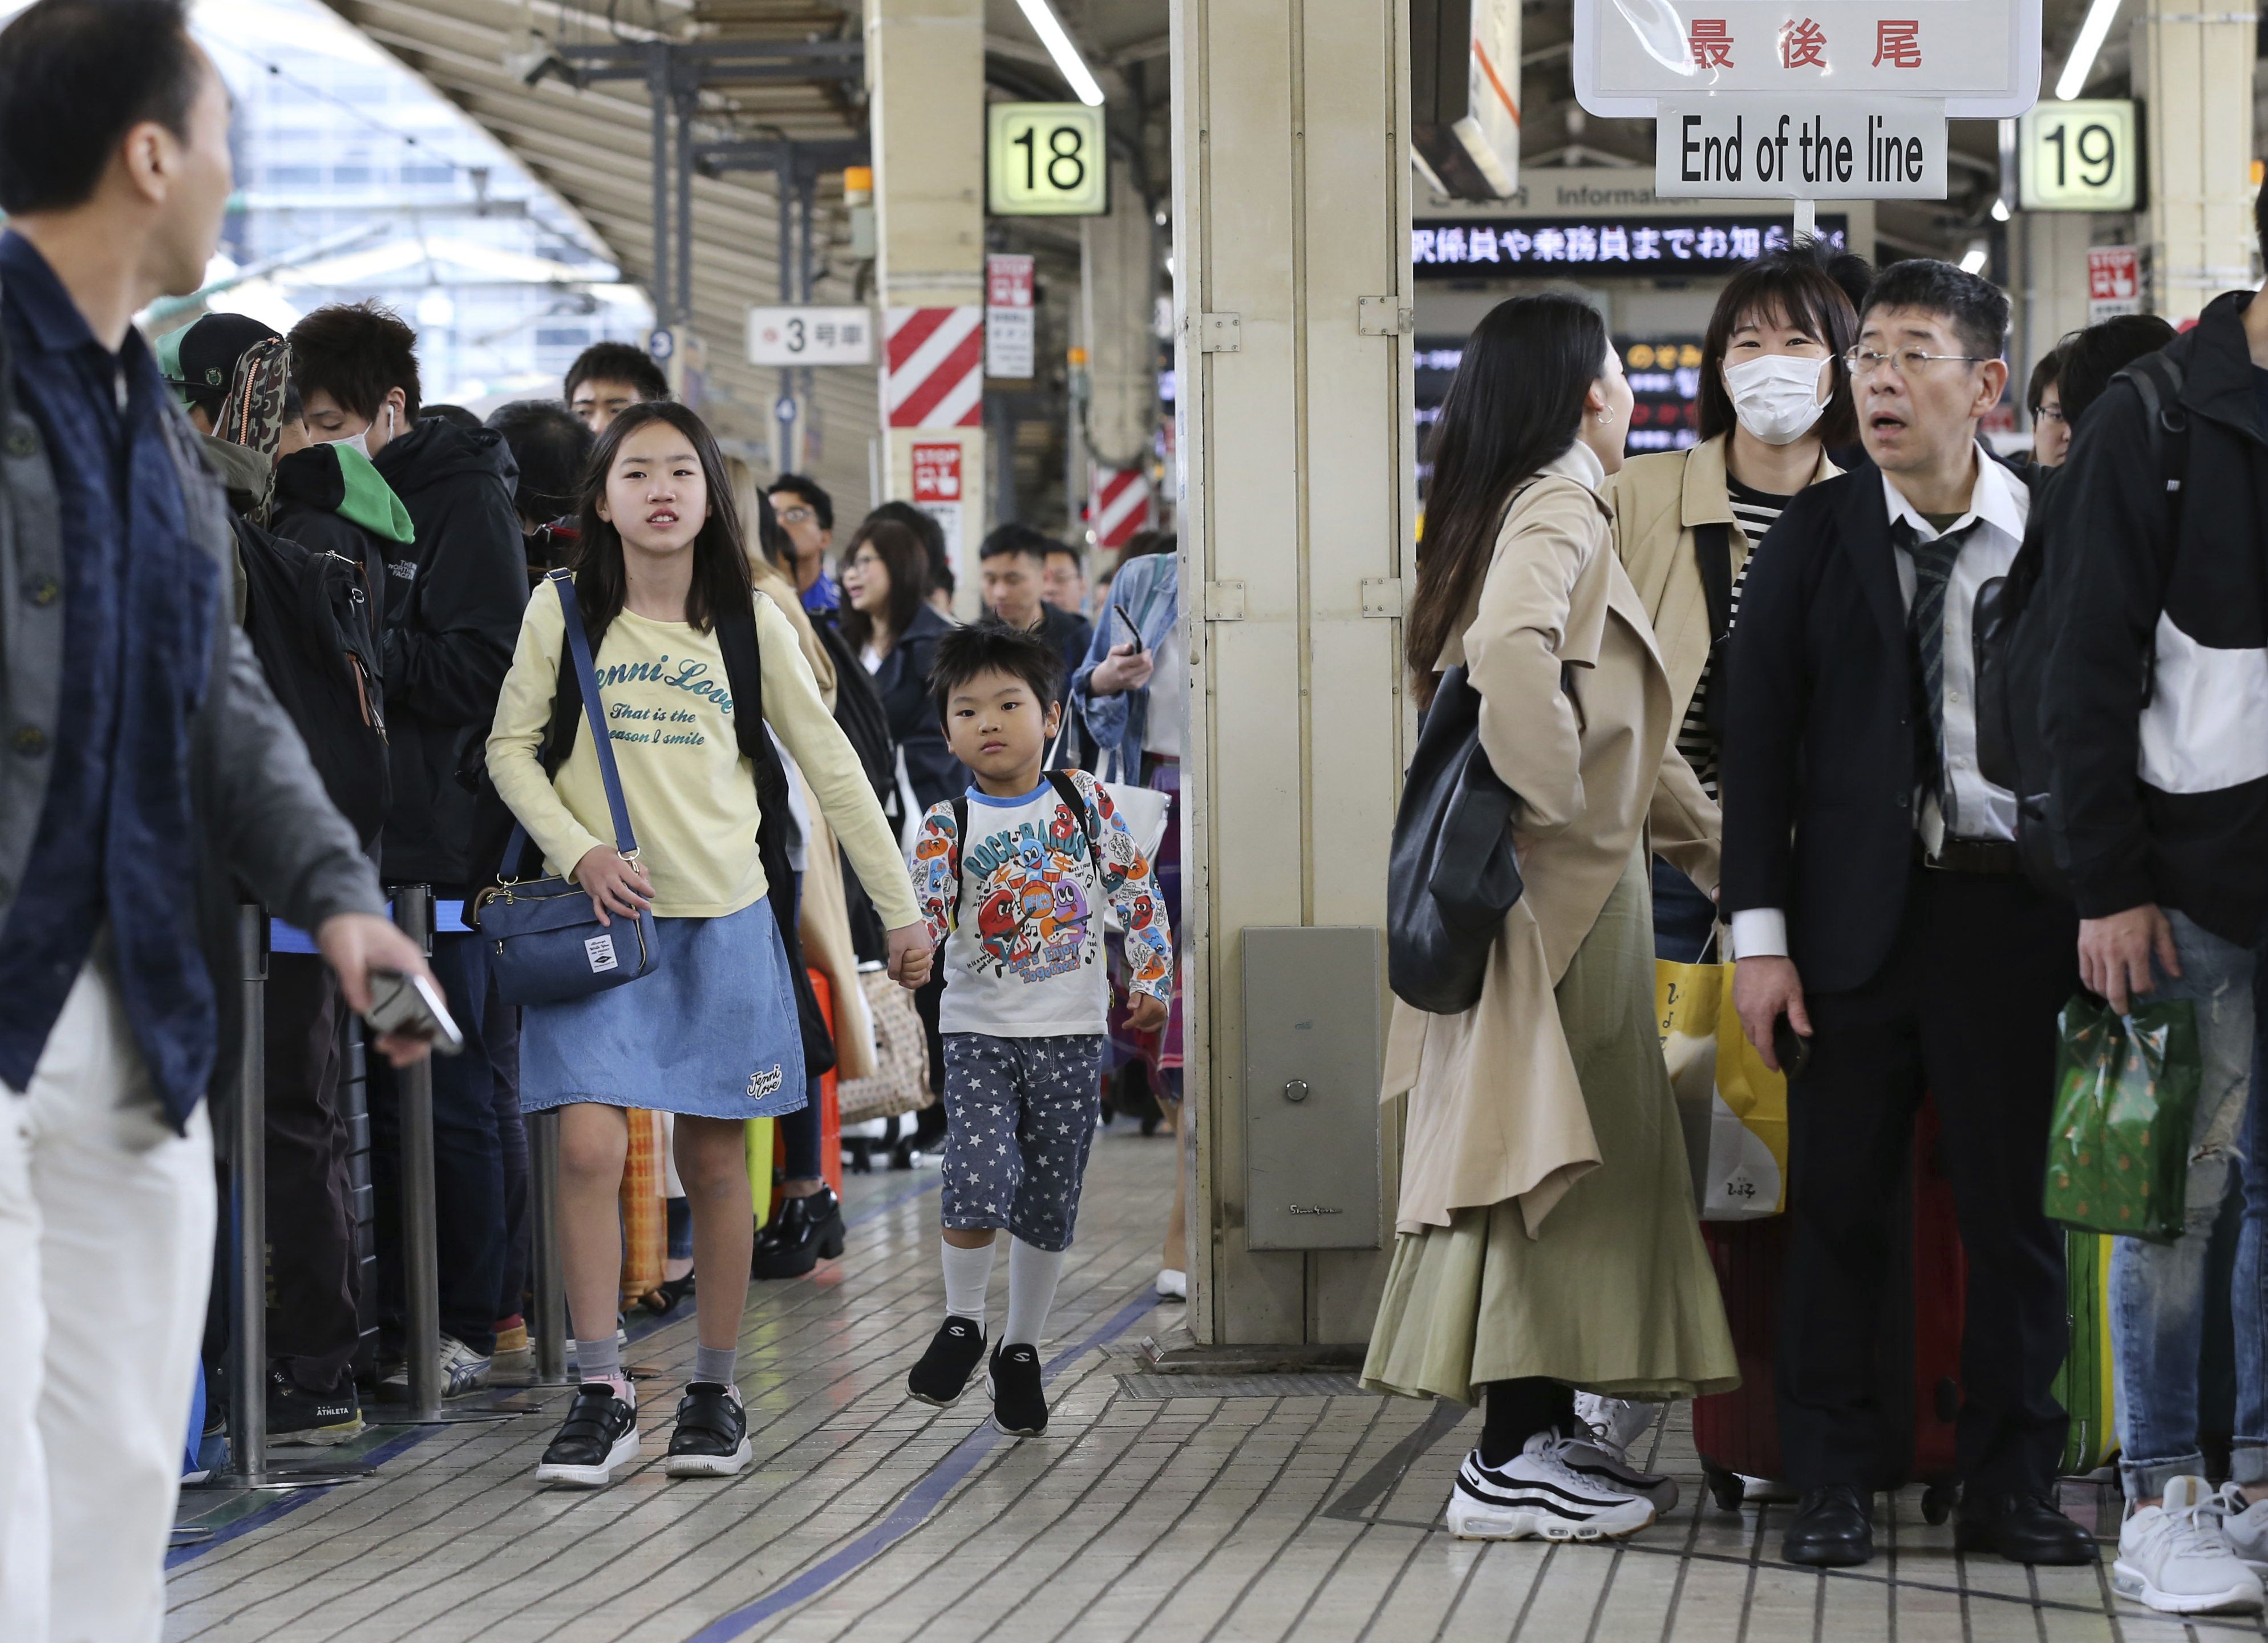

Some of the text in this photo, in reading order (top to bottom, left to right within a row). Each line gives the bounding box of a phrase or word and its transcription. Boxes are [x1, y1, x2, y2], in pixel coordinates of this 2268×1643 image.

[1688, 18, 1922, 69] 最後尾
[1011, 127, 1085, 191] 18
[1682, 114, 1923, 183] End of the line
[2043, 124, 2116, 187] 19
[992, 261, 1032, 276] STOP
[914, 448, 961, 465] STOP
[594, 655, 734, 714] enni Love
[610, 702, 696, 723] That is the
[663, 732, 705, 746] smile
[963, 829, 1020, 881] ROCK
[1008, 941, 1079, 974] Let's Enjoy
[1019, 954, 1081, 984] Together!
[748, 1066, 781, 1094] Jenni
[317, 1407, 349, 1416] ATHLETA
